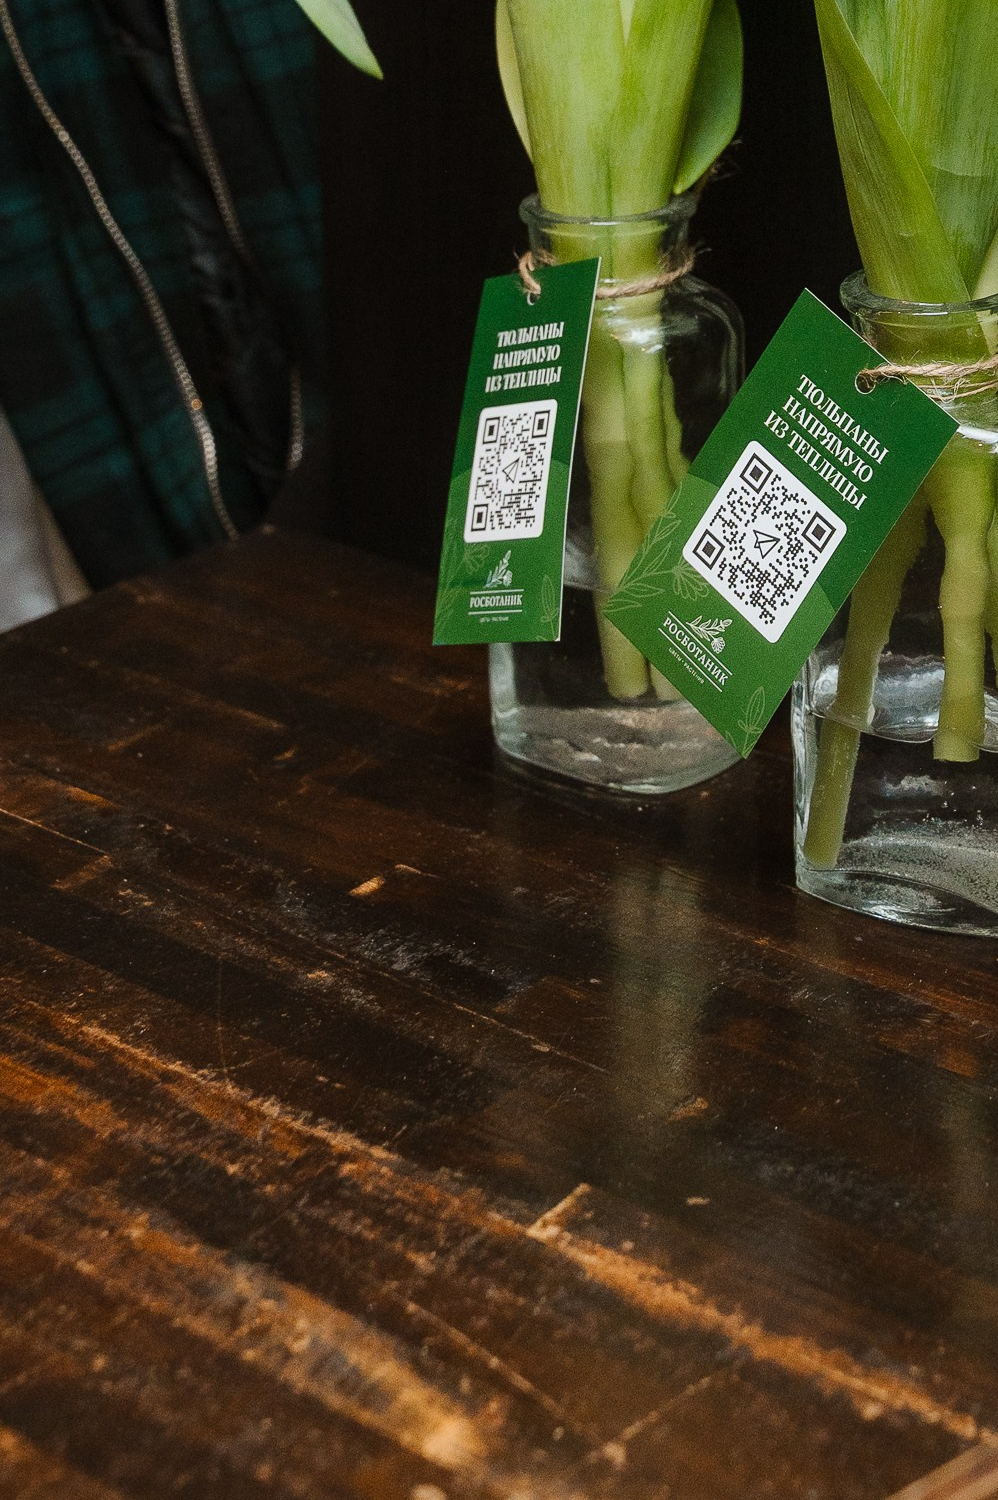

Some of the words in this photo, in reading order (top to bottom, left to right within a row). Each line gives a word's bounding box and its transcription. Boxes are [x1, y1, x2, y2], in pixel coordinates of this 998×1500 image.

[493, 344, 561, 370] НАПРЯМУЮ
[497, 321, 565, 348] ТЮЛЬПАНЫ
[485, 375, 502, 393] ИЗ
[503, 366, 562, 390] ТЕПЛИЦЫ
[782, 394, 873, 483] НАПРЯМУЮ
[796, 374, 889, 465] ТЮЛЬПАНЫ
[764, 409, 790, 439] ИЗ
[787, 430, 868, 511] ТЕПЛИЦЫ
[470, 594, 523, 608] РОСБОТАНИК
[663, 617, 729, 686] РОСБОТАНИК
